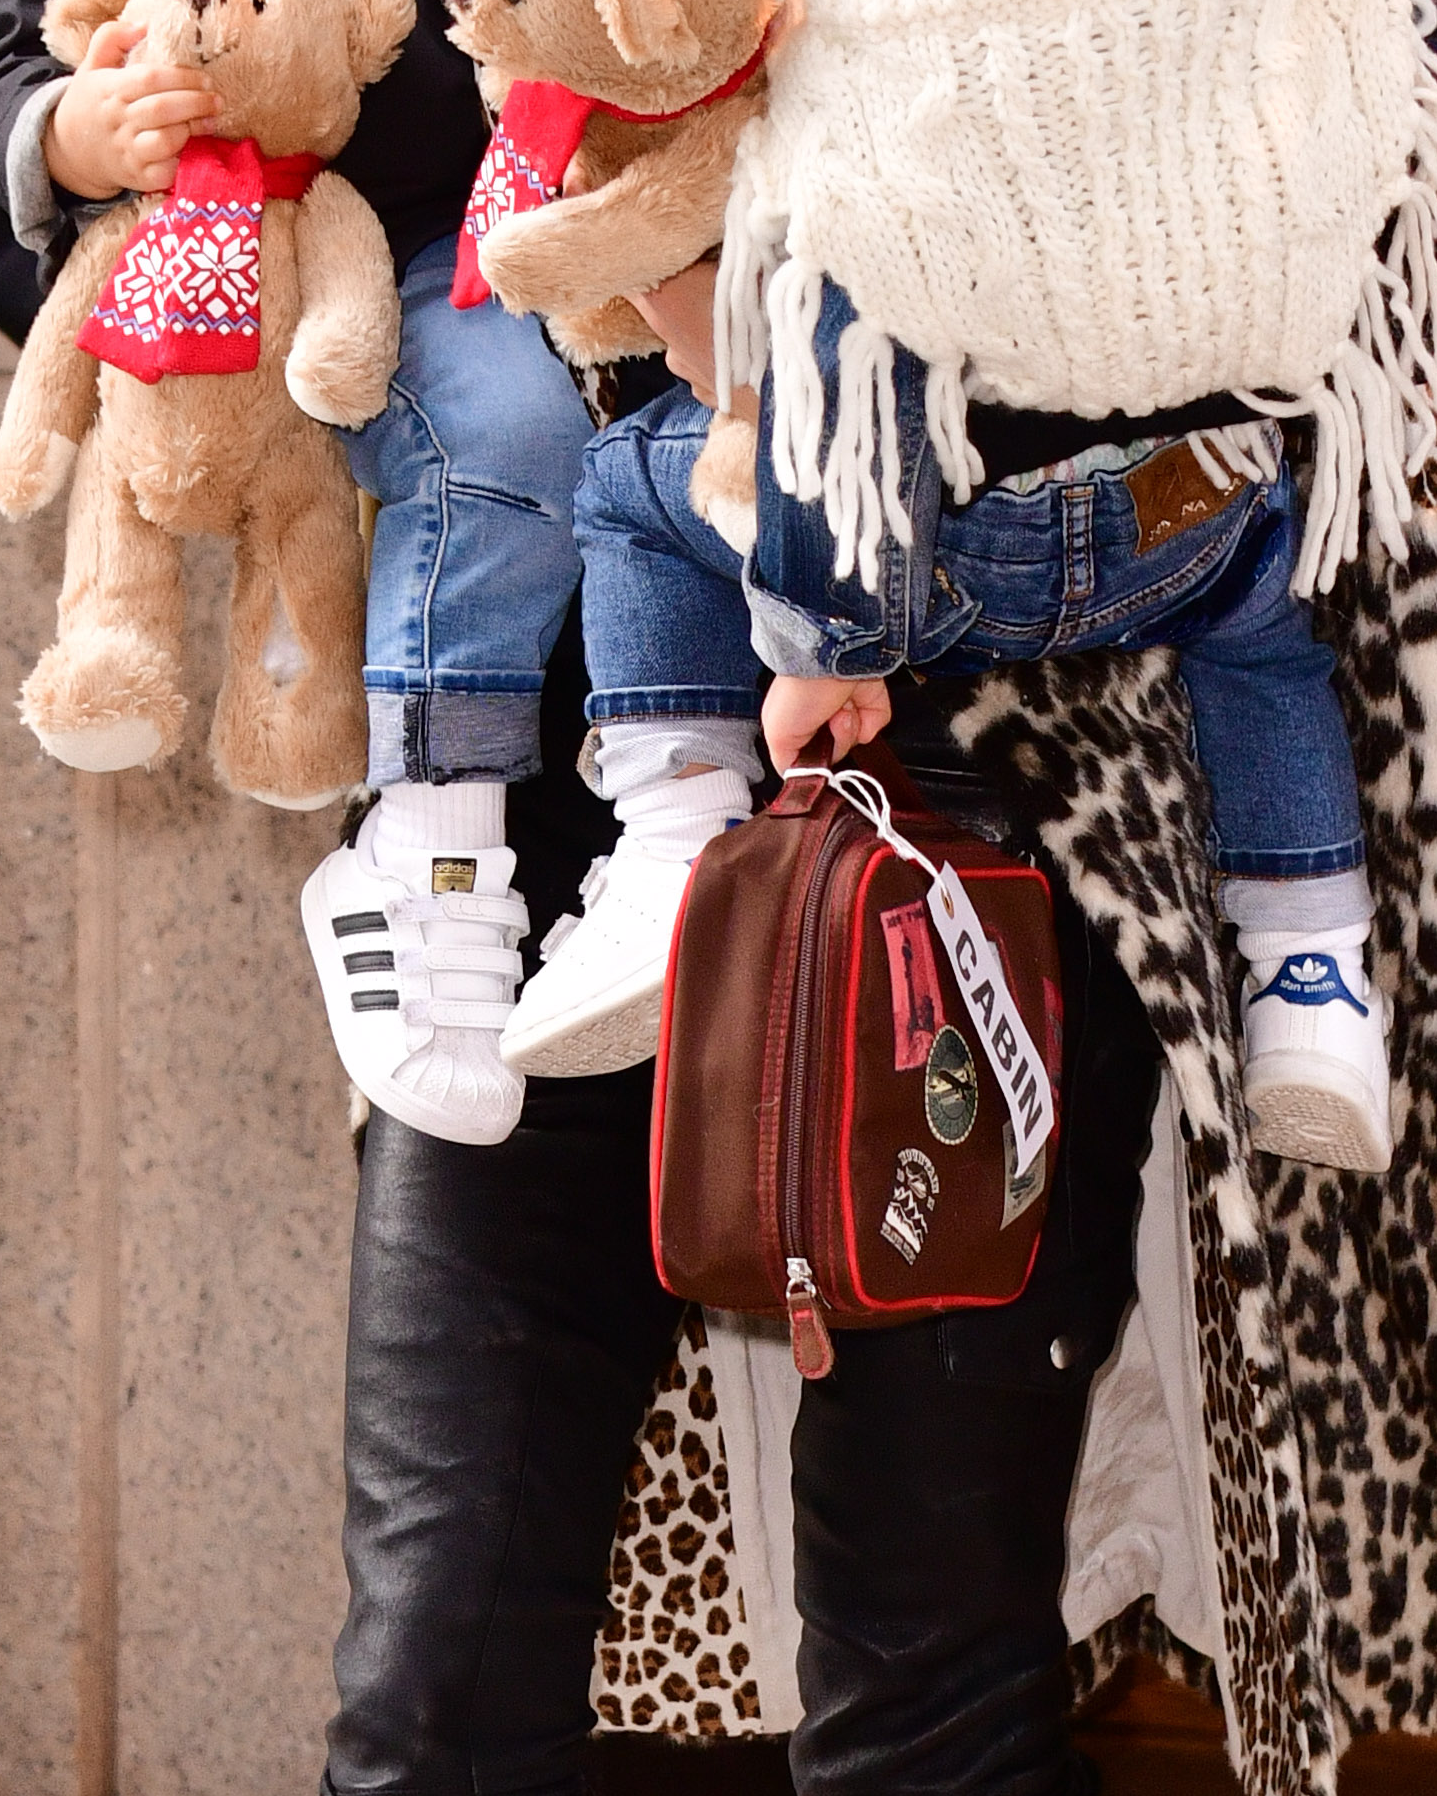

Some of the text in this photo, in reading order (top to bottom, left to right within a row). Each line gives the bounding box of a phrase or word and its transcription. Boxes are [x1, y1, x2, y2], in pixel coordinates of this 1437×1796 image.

[433, 861, 475, 874] adidas
[1278, 978, 1336, 994] stan smith
[955, 929, 1043, 1141] CABIN
